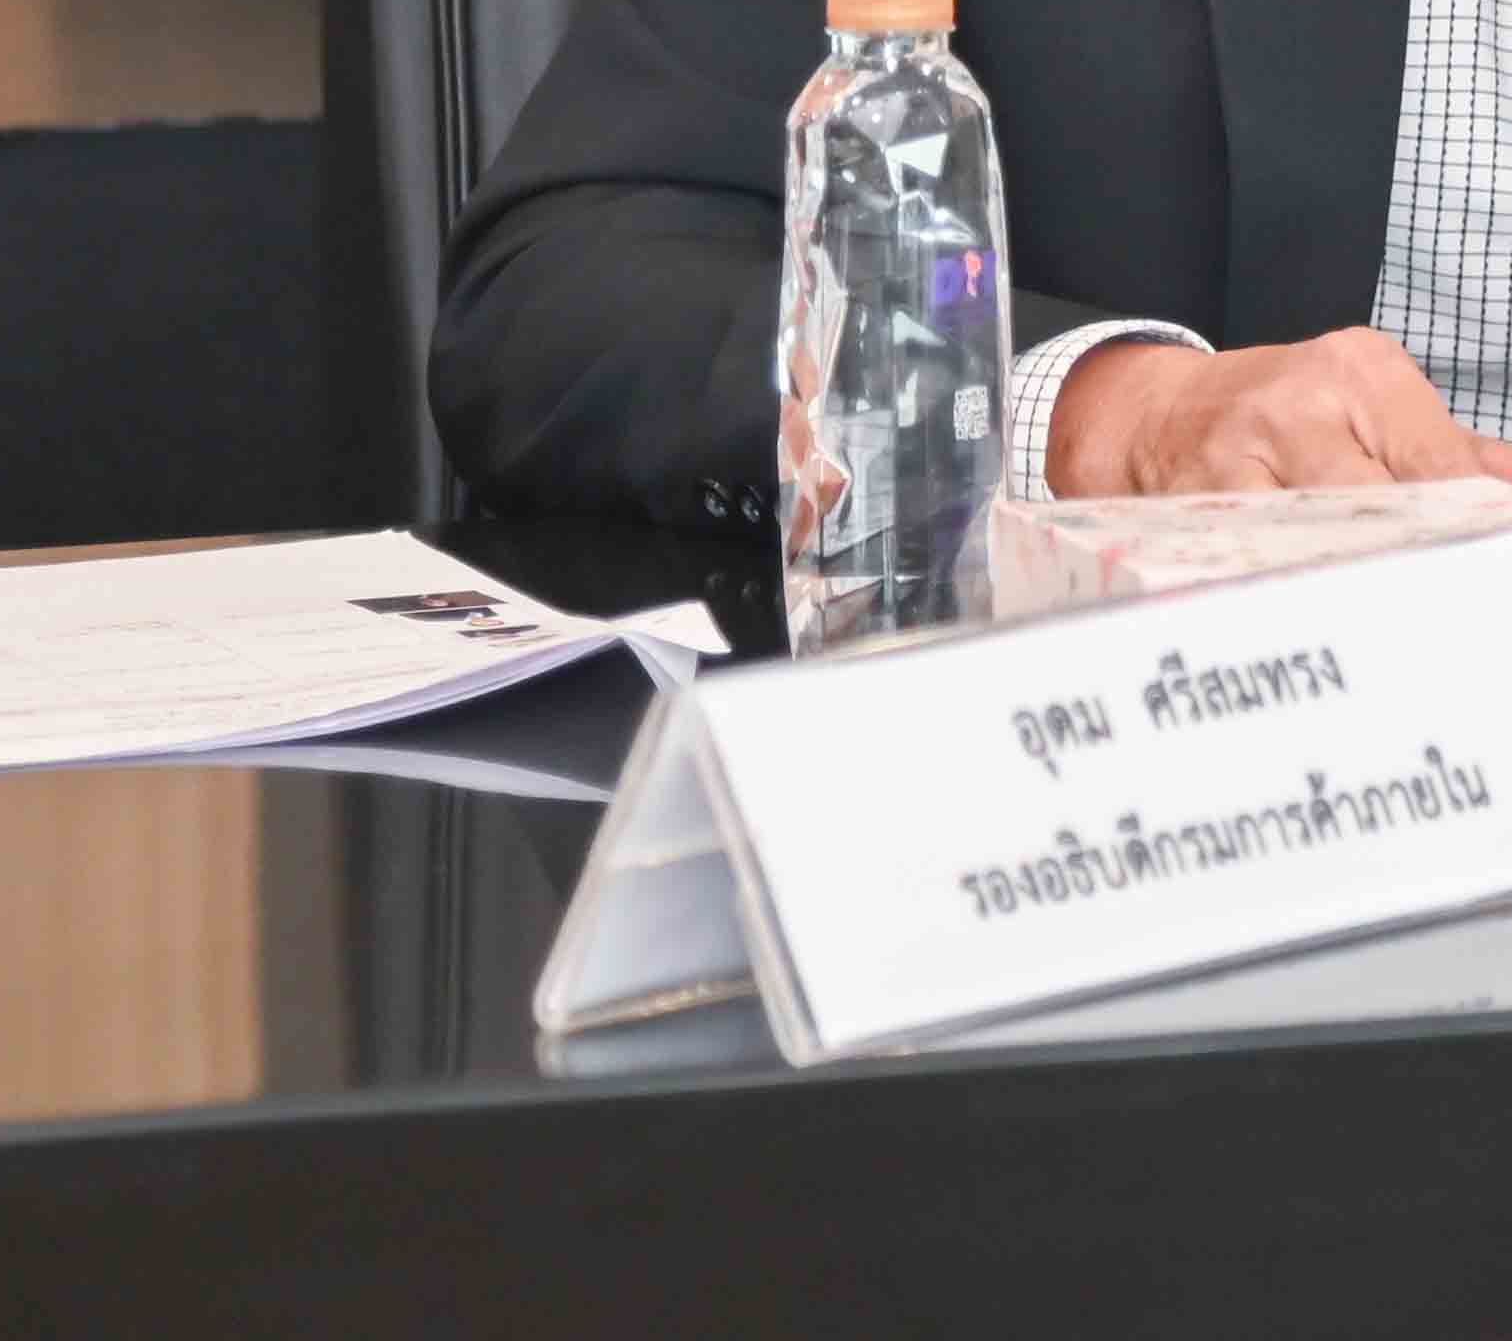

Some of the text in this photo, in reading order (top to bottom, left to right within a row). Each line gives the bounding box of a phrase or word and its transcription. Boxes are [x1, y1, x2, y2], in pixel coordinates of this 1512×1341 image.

[1012, 694, 1113, 780] อุดม
[959, 744, 1491, 918] รองอธิบดีกรมการค้าภายใน
